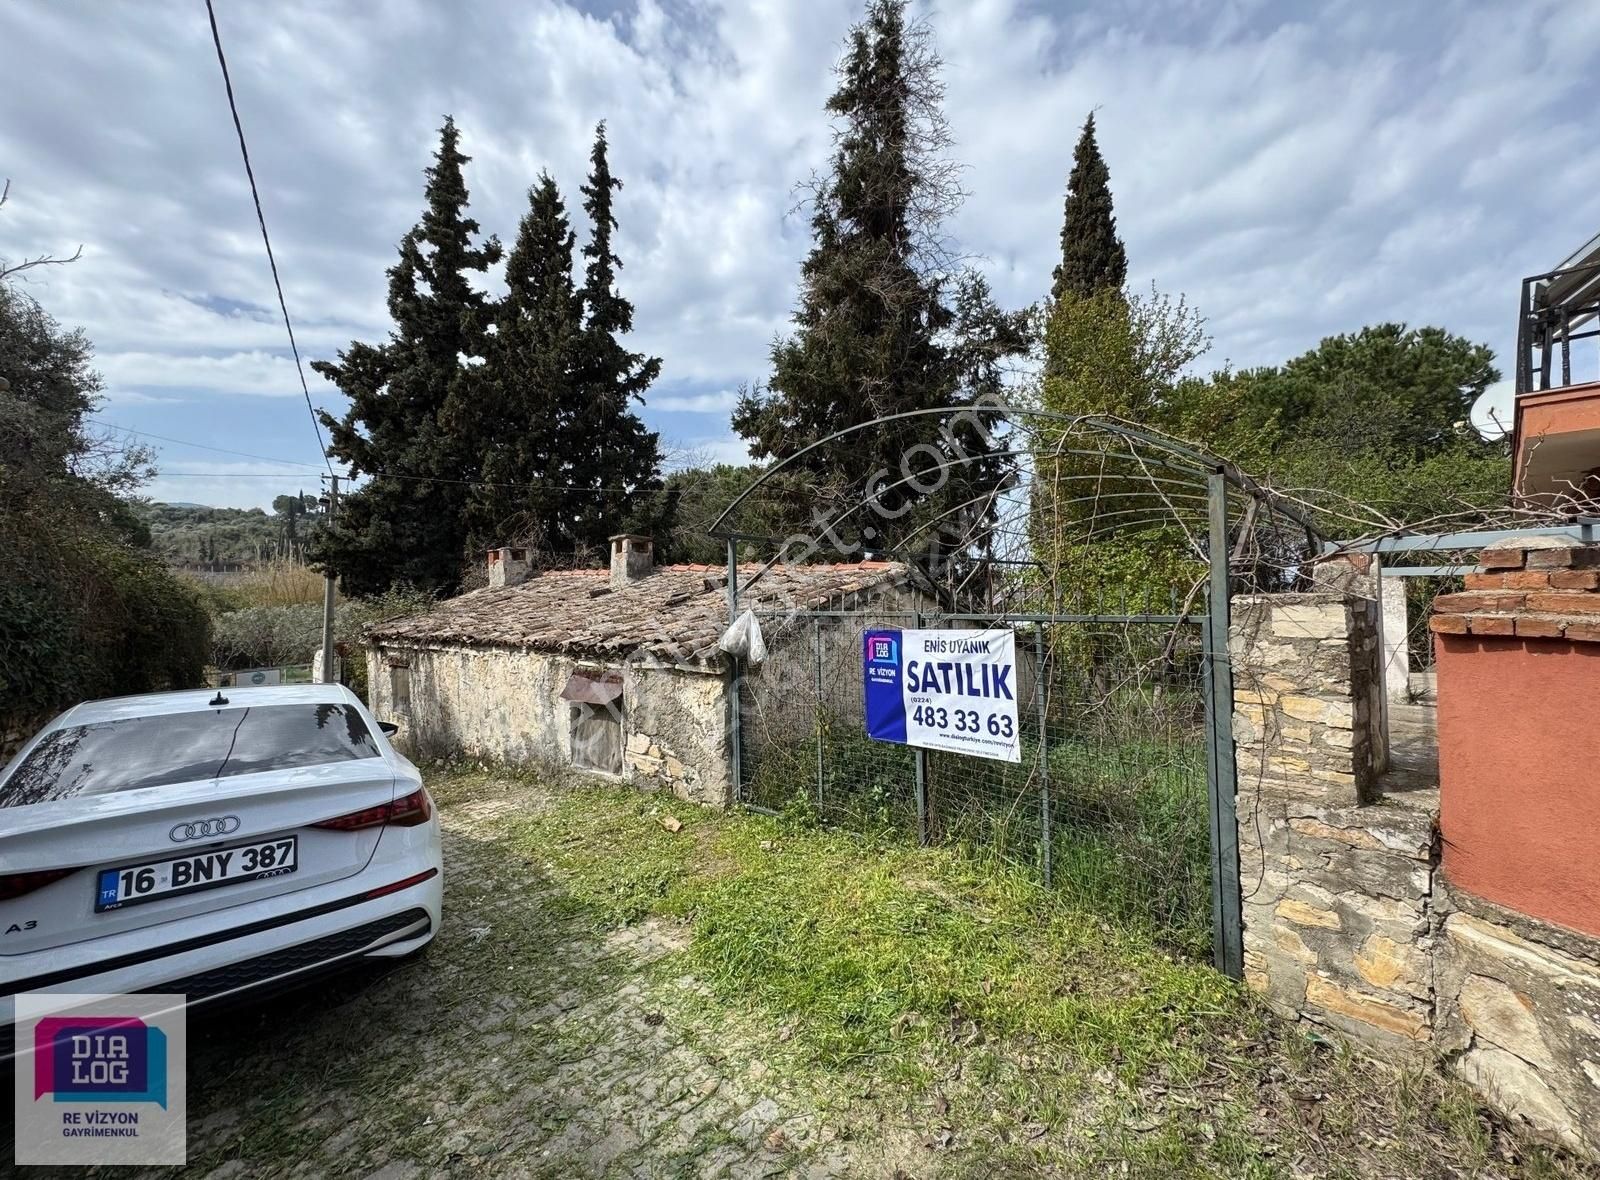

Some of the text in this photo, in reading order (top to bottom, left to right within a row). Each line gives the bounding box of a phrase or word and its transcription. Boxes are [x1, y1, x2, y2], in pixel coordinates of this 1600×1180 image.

[924, 637, 991, 654] ENİS UYANIK
[907, 660, 1014, 700] SATILIK
[910, 696, 932, 704] (0224)
[913, 705, 1014, 738] 483 33 63
[121, 841, 293, 897] 16 BNY 387
[102, 889, 117, 899] TR
[5, 920, 38, 935] A3
